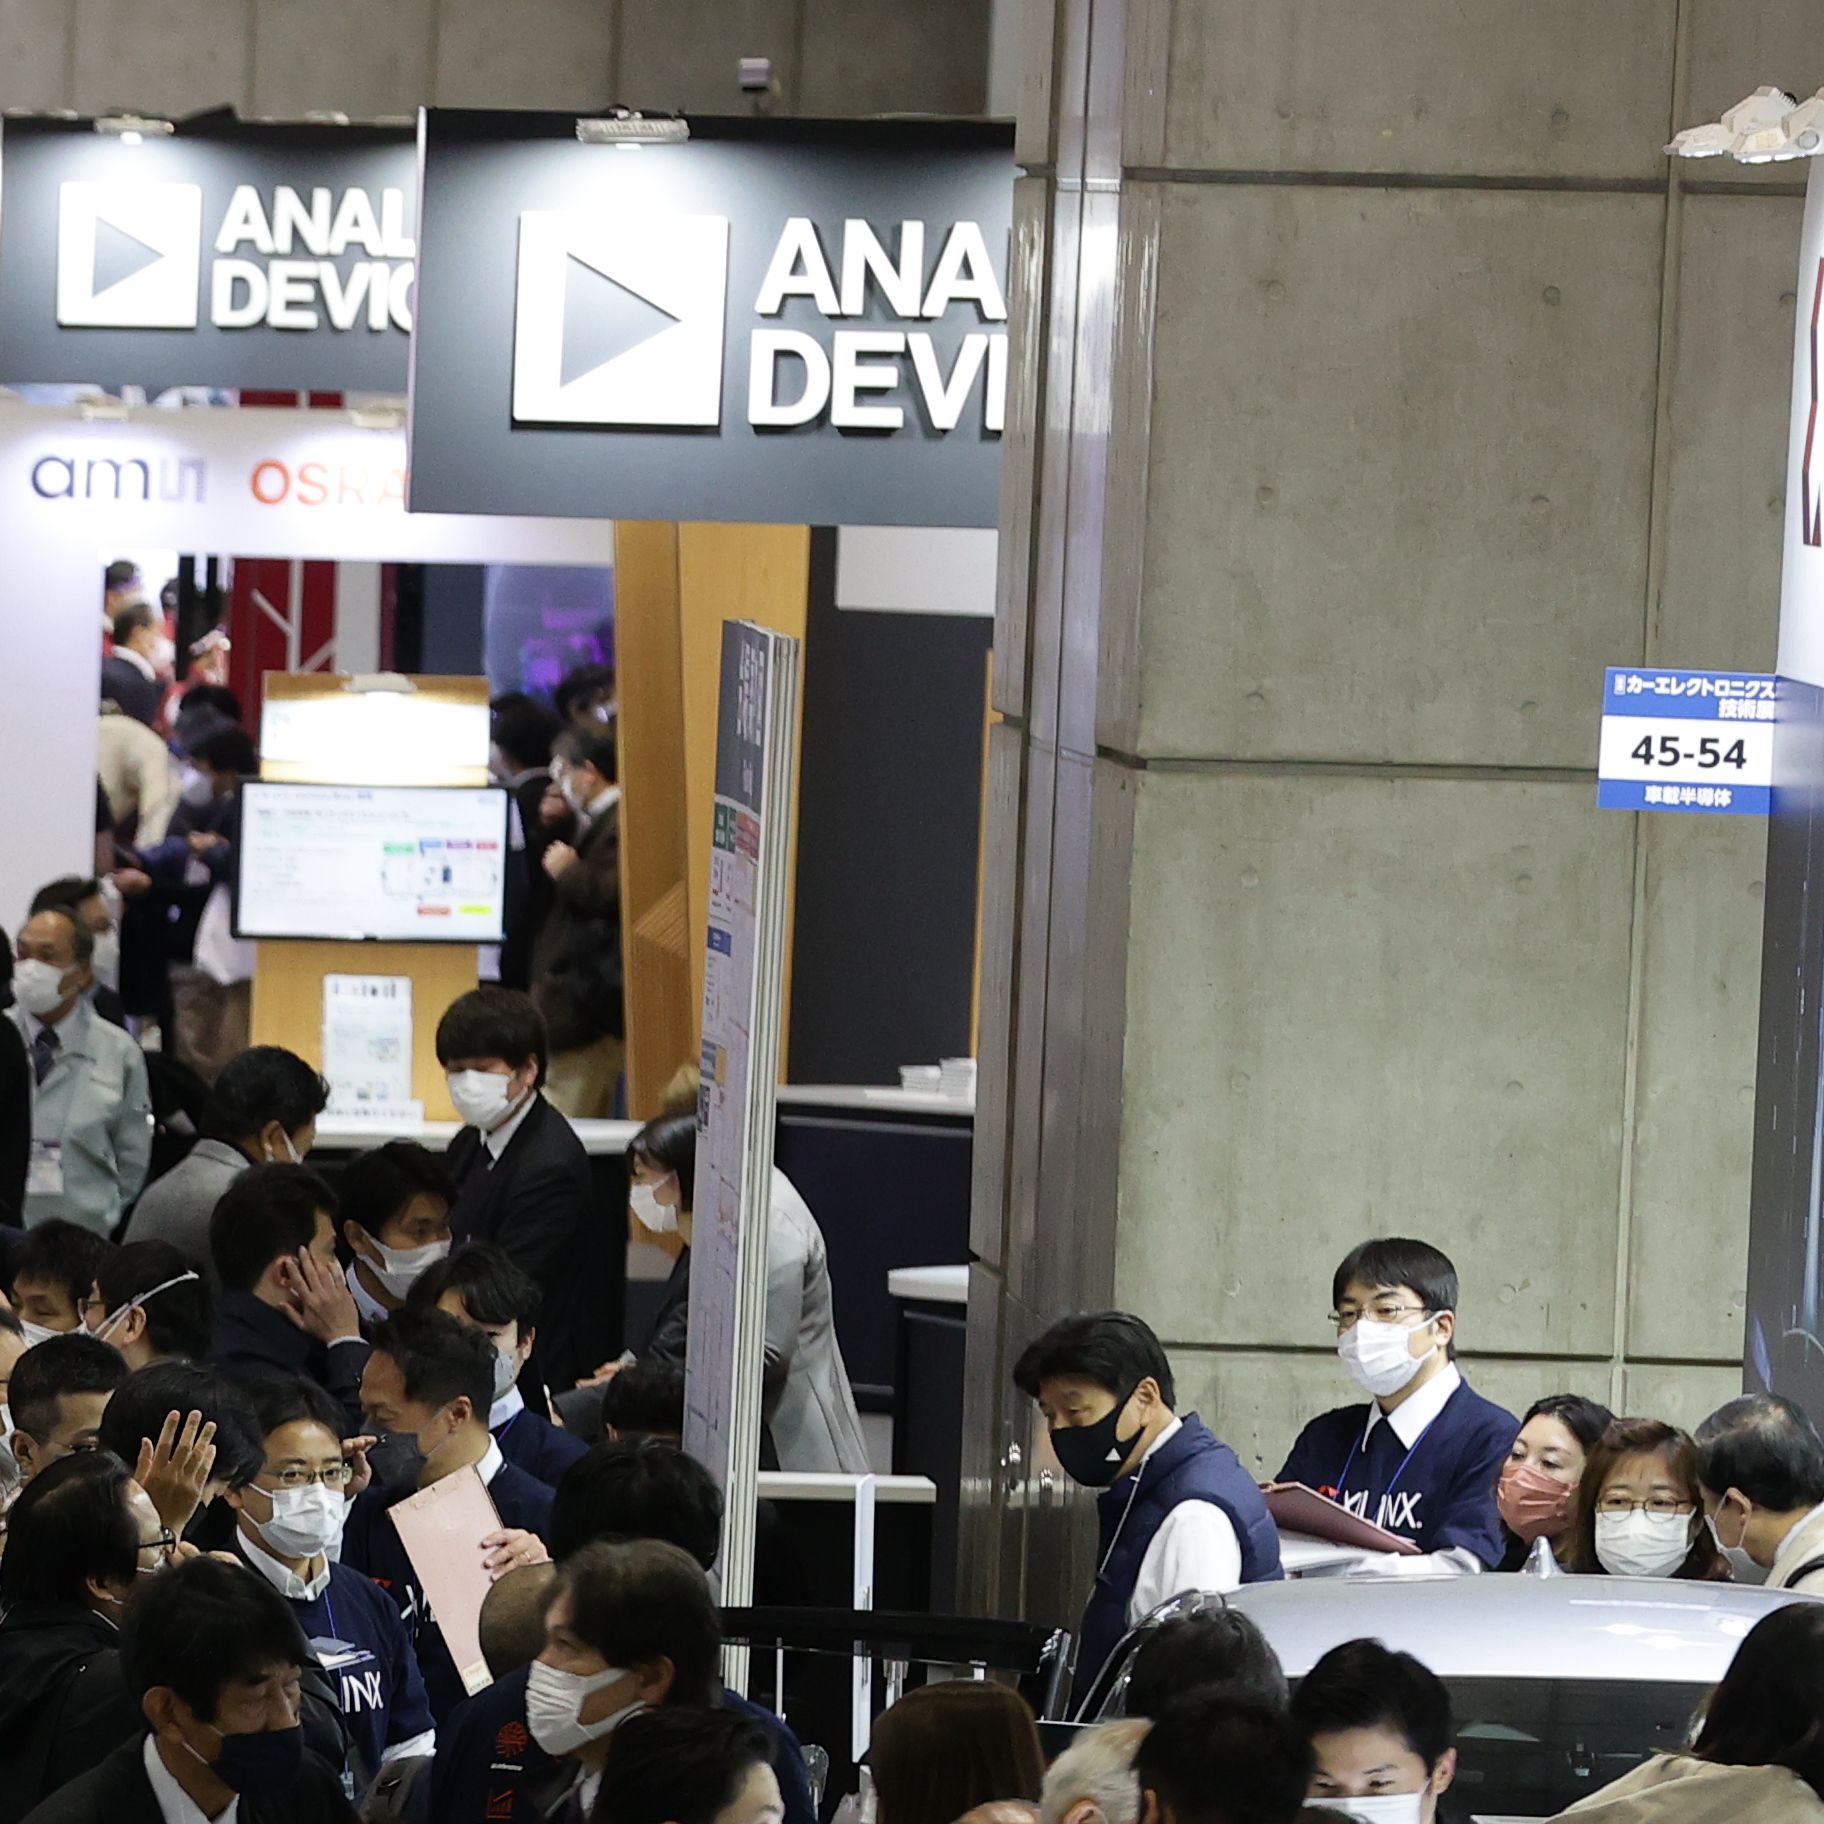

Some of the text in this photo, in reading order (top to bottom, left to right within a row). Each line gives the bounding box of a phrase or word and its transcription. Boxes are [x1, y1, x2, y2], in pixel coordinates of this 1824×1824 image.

[214, 185, 417, 258] ANAL
[754, 217, 1008, 320] ANA
[748, 329, 1009, 431] DEVI
[1627, 674, 1776, 699] カーエレクトロニクス
[1718, 697, 1776, 720] 技術展
[1631, 735, 1748, 770] 45-54
